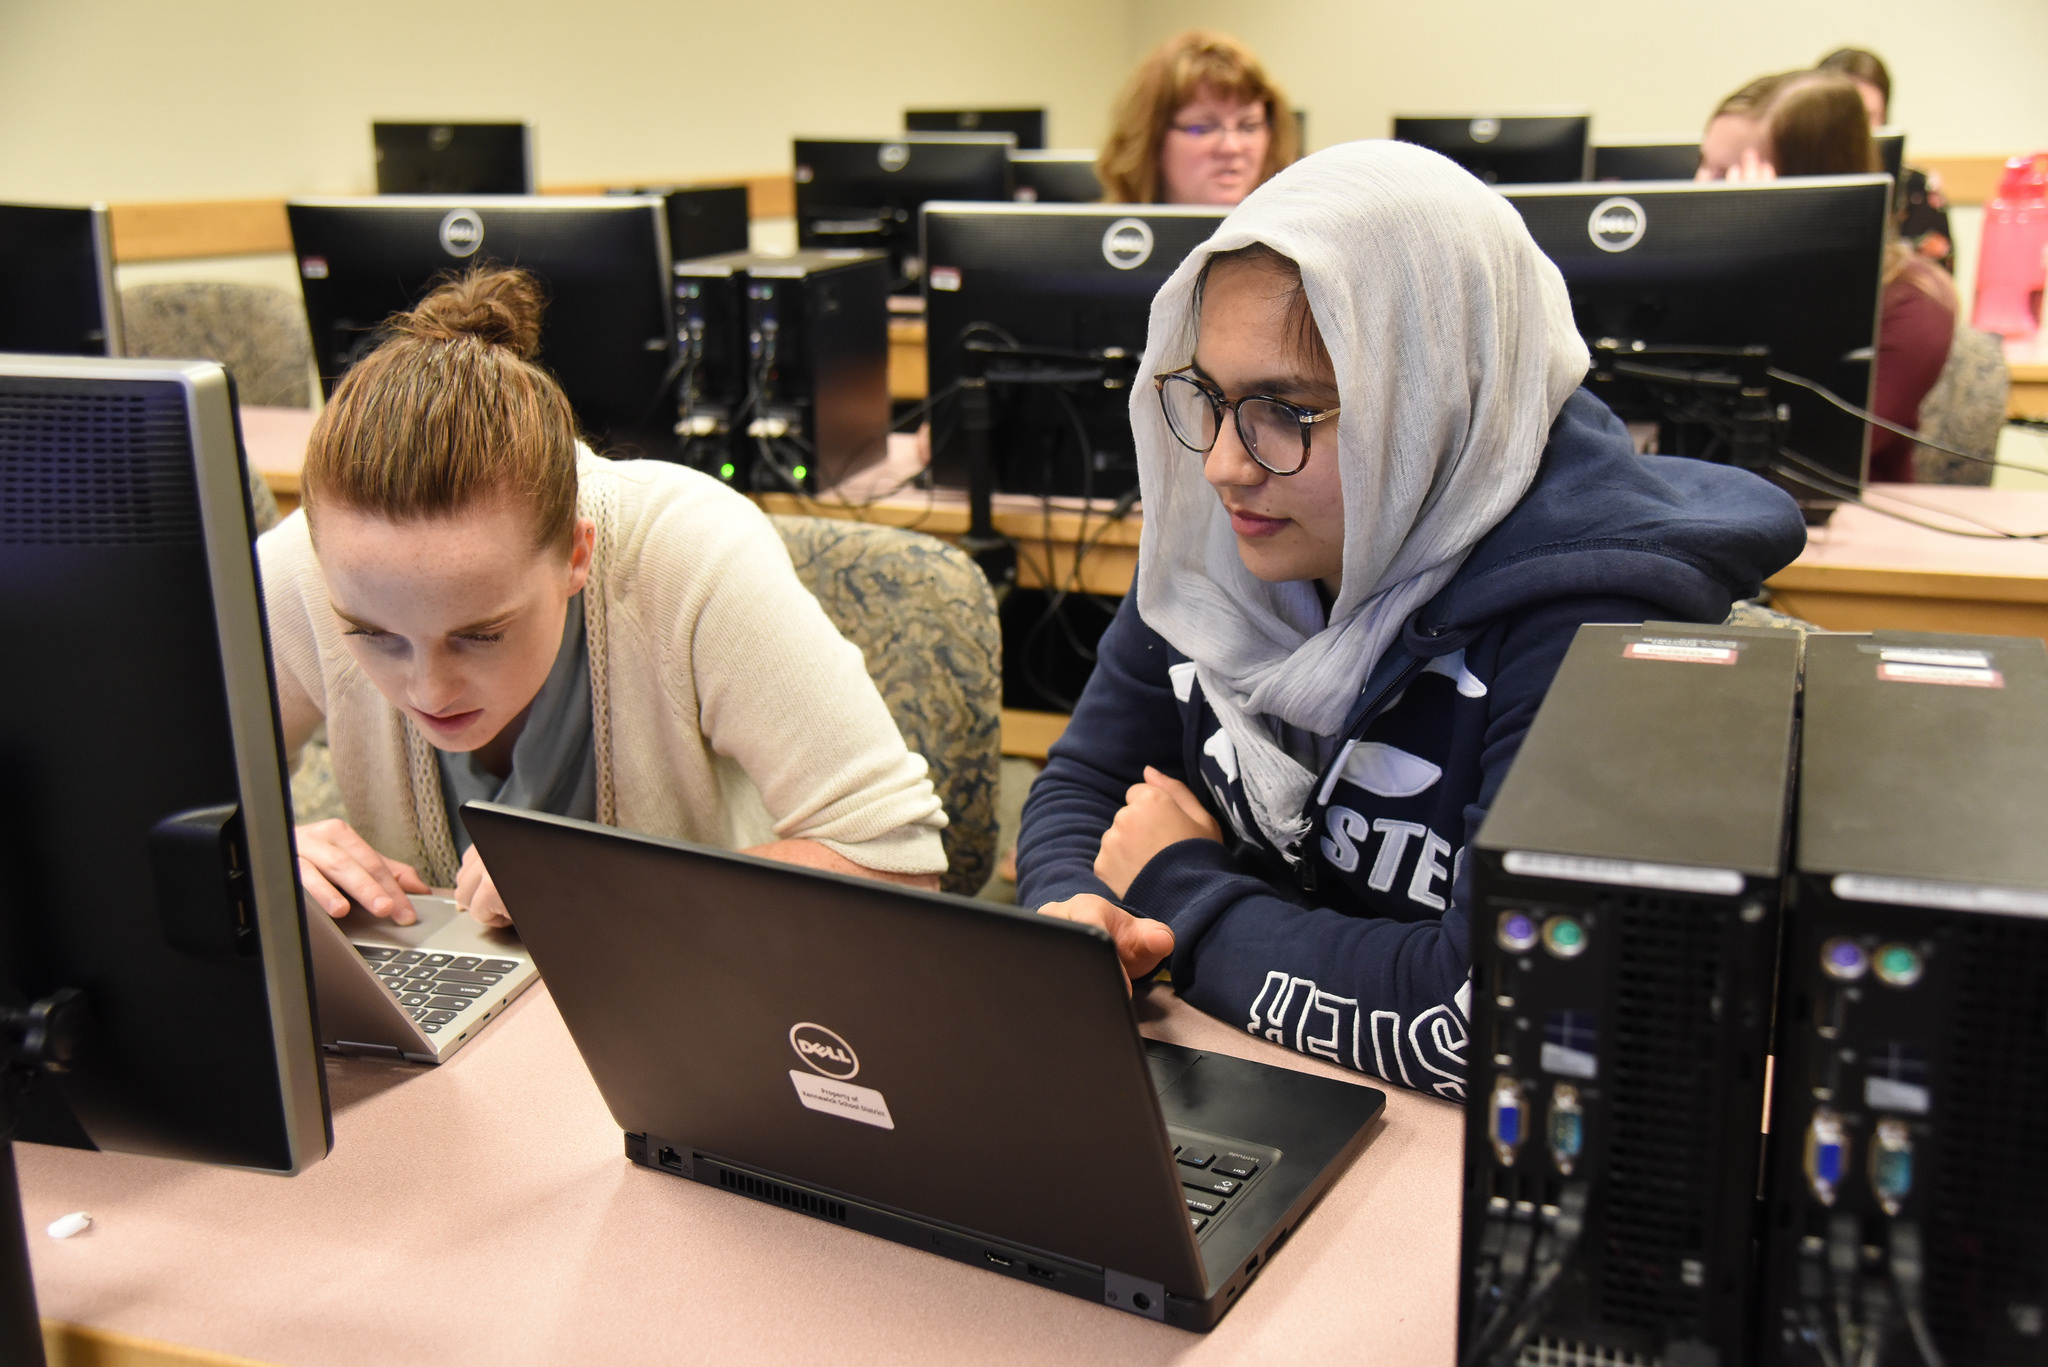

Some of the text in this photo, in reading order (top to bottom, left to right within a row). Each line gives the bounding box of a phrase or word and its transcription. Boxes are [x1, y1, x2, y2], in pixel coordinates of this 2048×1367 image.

[1320, 805, 1464, 911] STE
[797, 1038, 852, 1064] DELL
[821, 1087, 850, 1102] Property
[1228, 1151, 1260, 1163] Latitude
